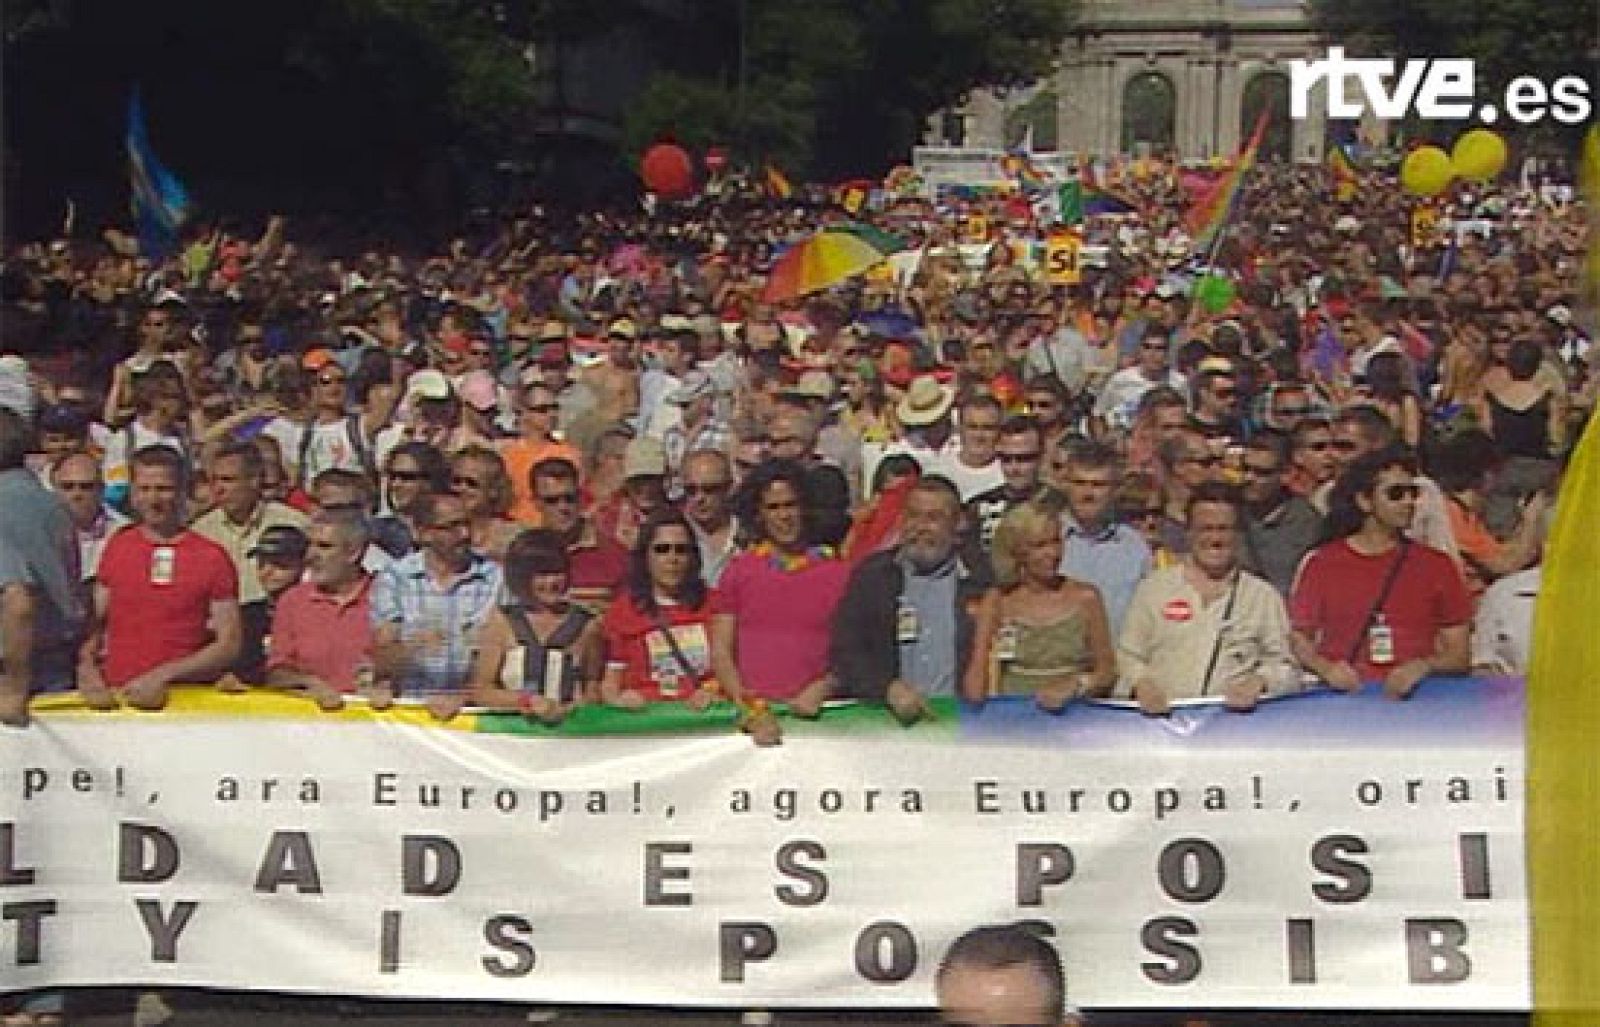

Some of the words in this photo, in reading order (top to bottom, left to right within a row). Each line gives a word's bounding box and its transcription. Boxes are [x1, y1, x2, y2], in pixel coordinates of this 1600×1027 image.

[215, 777, 321, 803] ara
[372, 773, 676, 821] Europa!,
[729, 788, 924, 821] agora
[973, 774, 1301, 821] Europa!,
[1356, 766, 1508, 806] orai
[644, 841, 830, 907] ES
[1016, 832, 1493, 905] POSI
[2, 899, 200, 966] TY
[380, 910, 537, 976] IS
[718, 916, 1473, 986] POSIB
